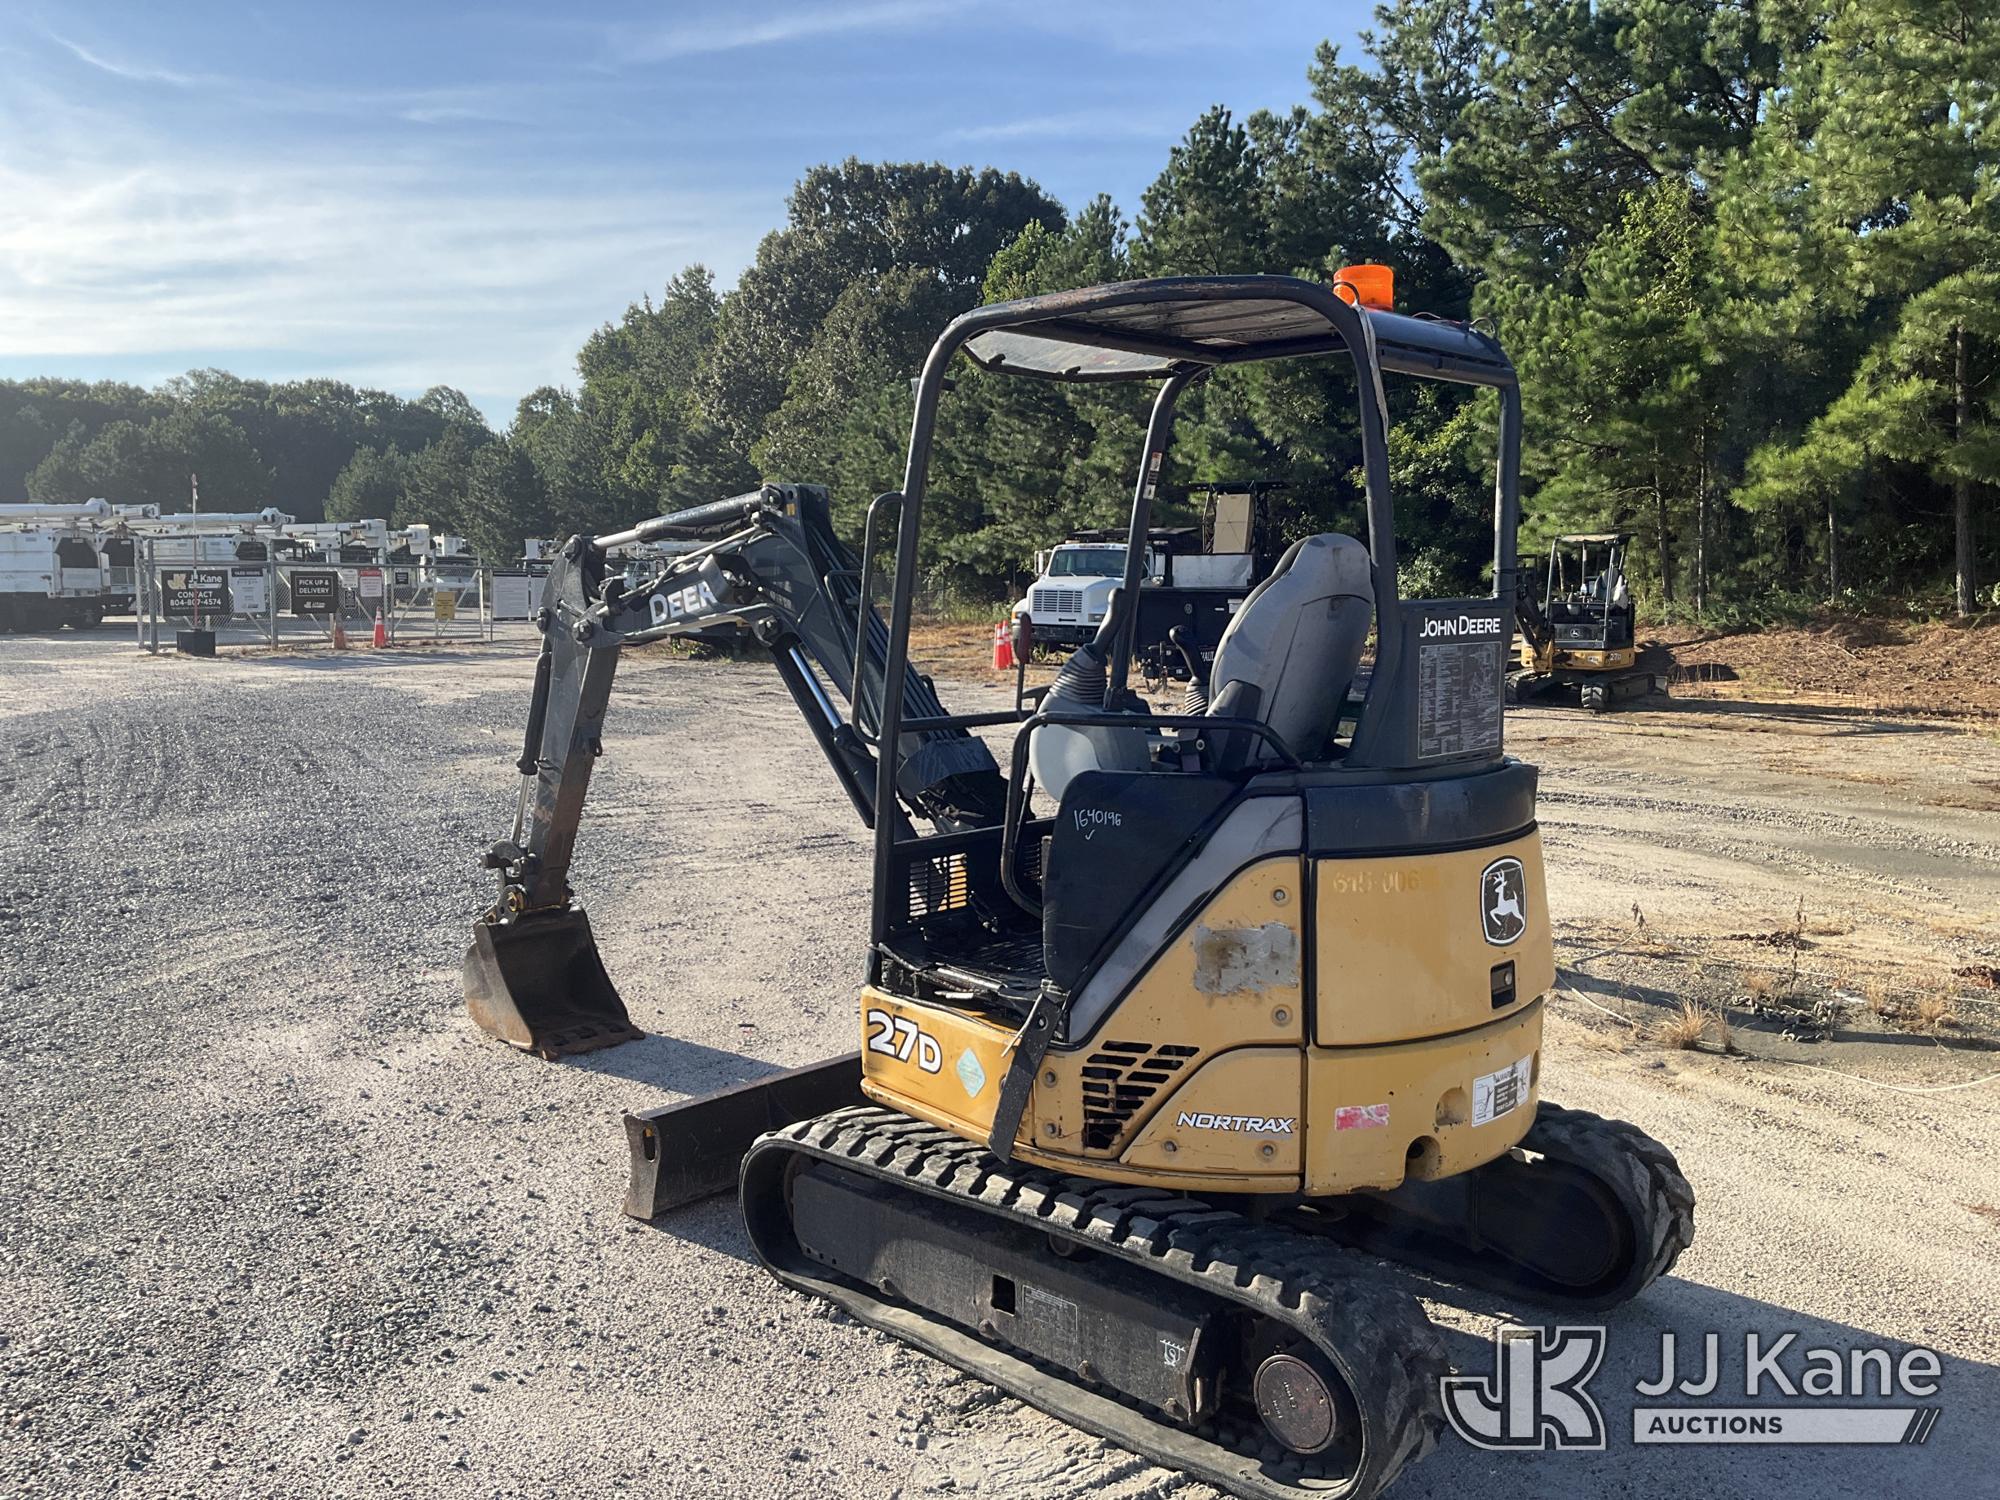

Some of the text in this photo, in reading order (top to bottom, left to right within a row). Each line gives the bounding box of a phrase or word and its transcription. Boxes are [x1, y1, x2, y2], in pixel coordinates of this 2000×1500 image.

[200, 574, 222, 583] Kane
[1420, 615, 1501, 637] JOHN DEERE
[867, 1008, 943, 1075] 27D
[1176, 1110, 1297, 1134] NORTRAX
